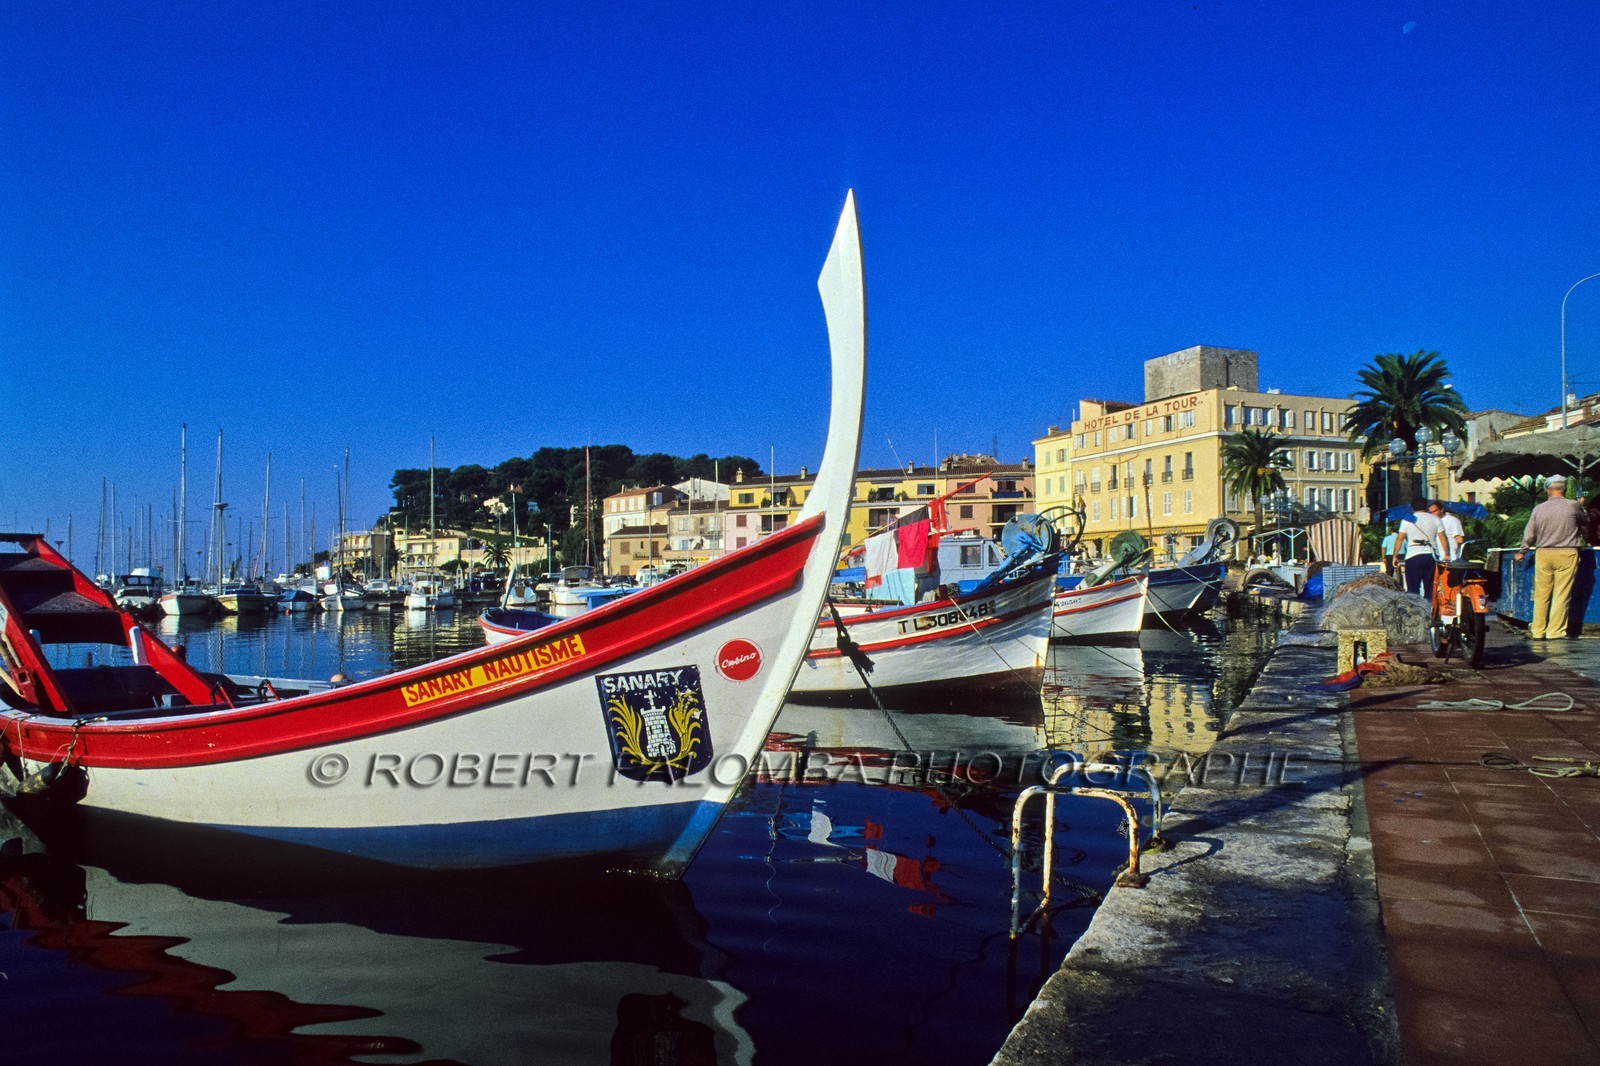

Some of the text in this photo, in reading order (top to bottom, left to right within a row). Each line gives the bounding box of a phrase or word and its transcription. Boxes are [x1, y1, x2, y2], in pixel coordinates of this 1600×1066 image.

[1083, 396, 1199, 431] HOTEL DE LA TOUR
[406, 637, 582, 704] SANARY NAUTISME
[603, 669, 684, 694] SANARY
